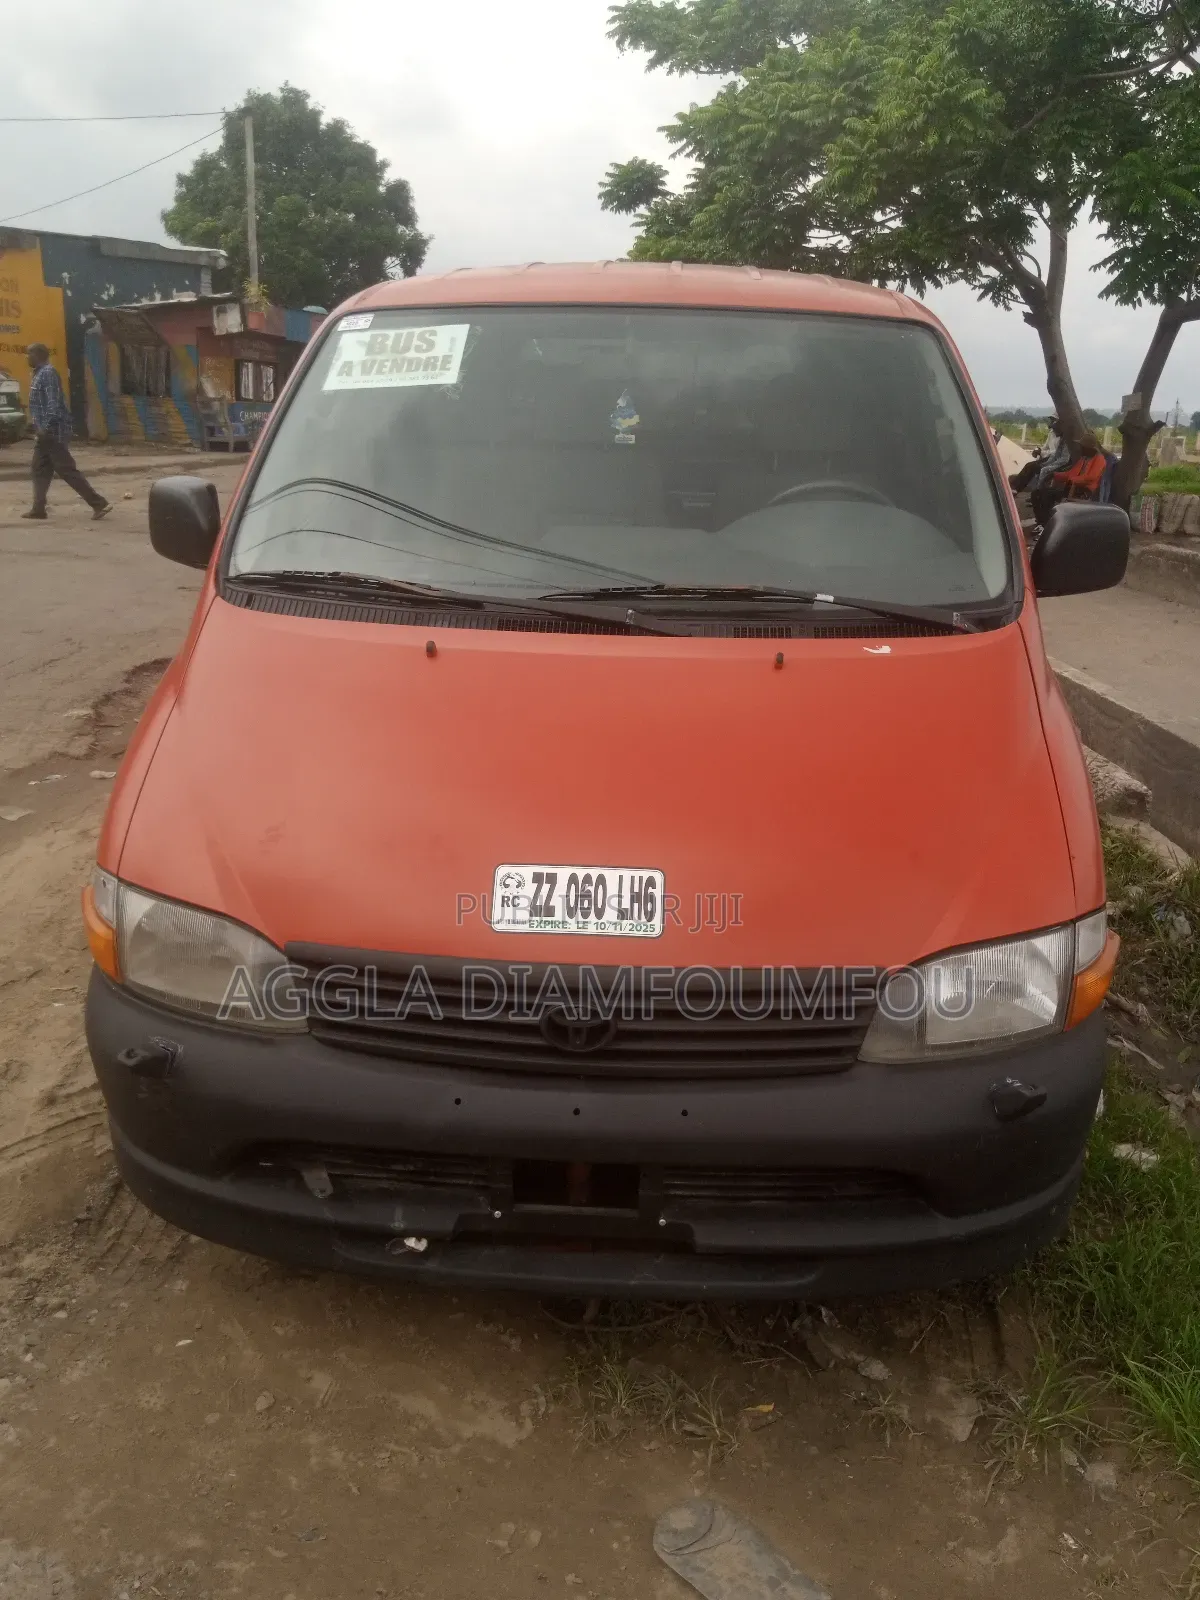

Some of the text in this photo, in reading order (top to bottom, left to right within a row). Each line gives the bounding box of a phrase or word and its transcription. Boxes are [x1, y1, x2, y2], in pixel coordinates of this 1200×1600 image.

[365, 330, 437, 356] BUS
[336, 354, 454, 377] A VENDRE
[501, 895, 521, 908] RC
[529, 872, 558, 918] ZZ
[565, 872, 607, 920] 060
[616, 874, 657, 923] LH6
[528, 919, 571, 930] EXPIRE:
[576, 920, 589, 930] LE
[593, 921, 656, 933] 10/11/2025
